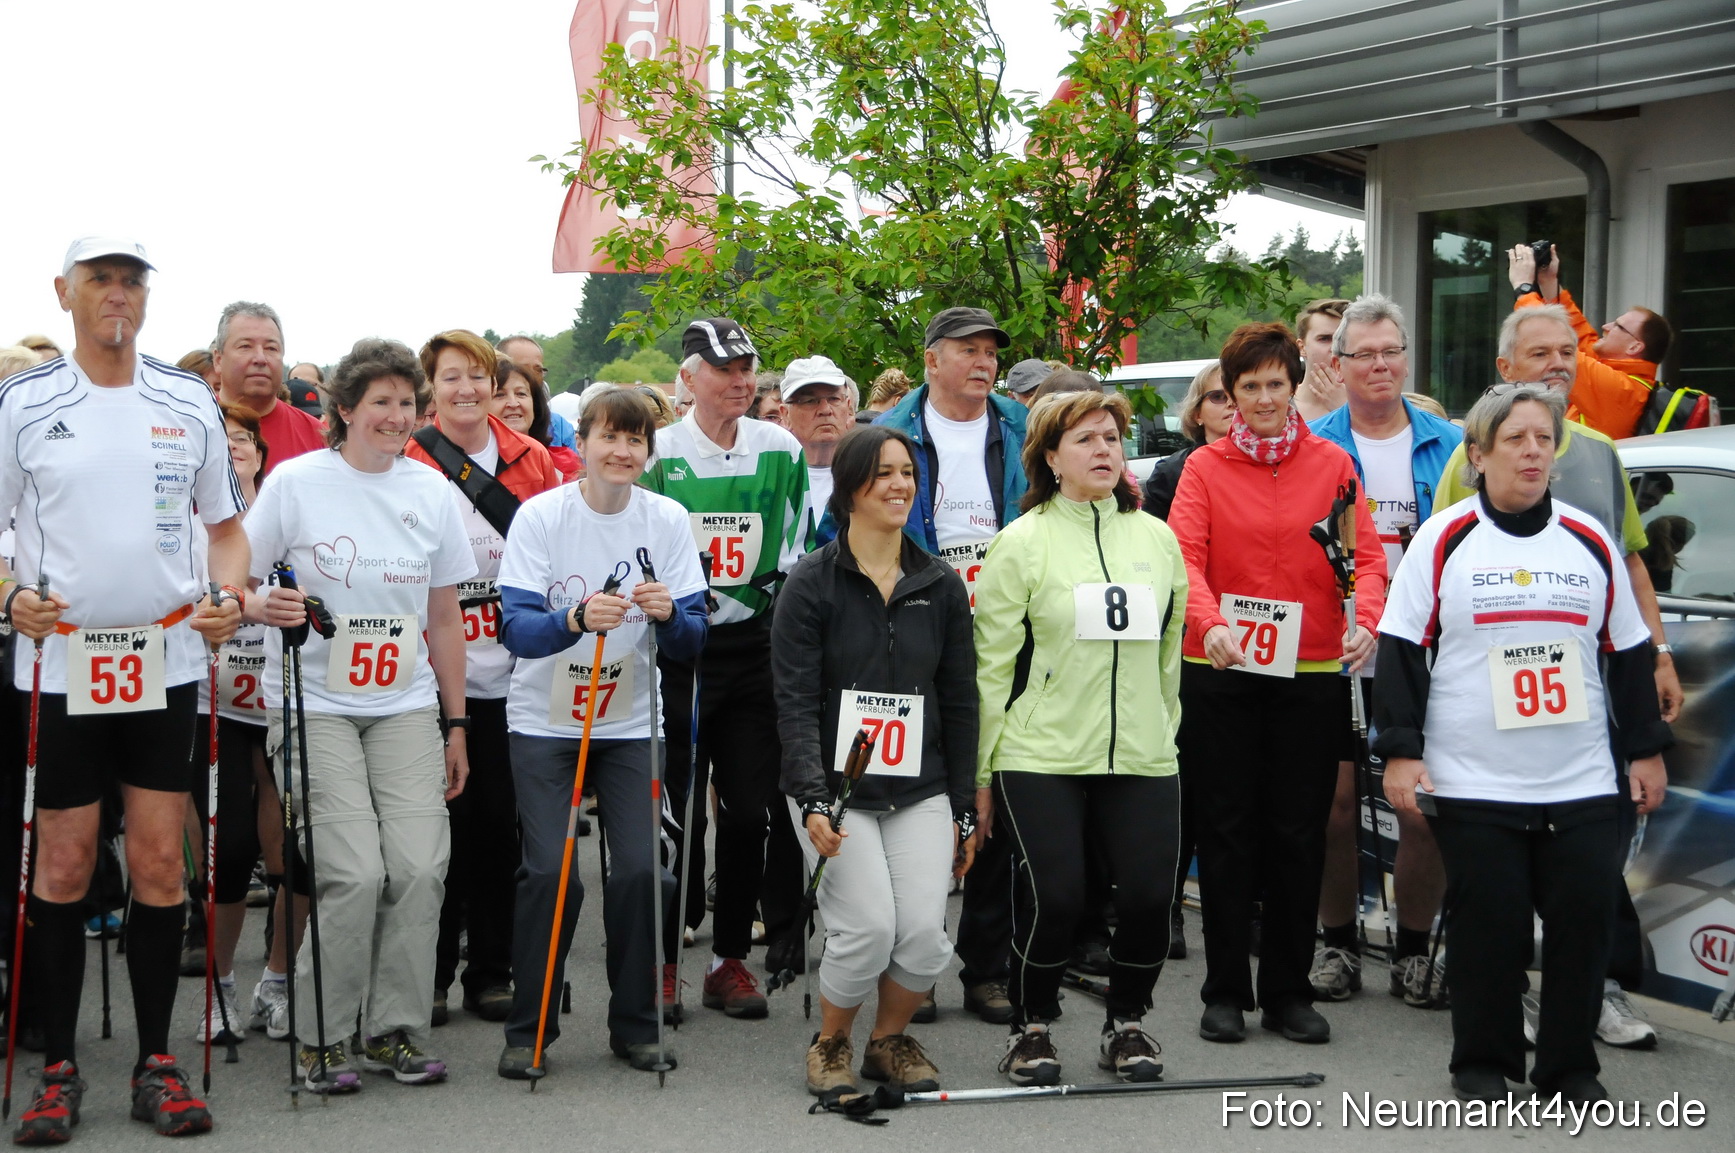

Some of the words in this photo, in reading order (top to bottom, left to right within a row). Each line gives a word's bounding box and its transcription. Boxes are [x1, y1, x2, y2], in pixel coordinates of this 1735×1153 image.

[44, 431, 76, 441] adidas
[151, 426, 186, 437] MERZ
[151, 441, 187, 452] SCHNELL
[943, 498, 975, 511] Sport
[702, 516, 737, 525] MEYER
[702, 524, 737, 532] WERBUNG
[318, 554, 345, 567] Herz
[357, 555, 388, 569] Sport
[707, 536, 745, 579] 45
[457, 589, 487, 597] ERBUNG
[1472, 594, 1516, 604] Regensburger
[1104, 585, 1129, 632] 8
[1233, 598, 1271, 612] MEYER
[1233, 607, 1271, 619] WERBUNG
[348, 618, 387, 628] MEYER
[461, 600, 498, 642] 59
[84, 632, 129, 643] MEYER
[348, 628, 388, 636] WERBUNG
[84, 643, 130, 652] WERBUNG
[1236, 618, 1278, 666] 79
[1504, 645, 1546, 659] MEYER
[227, 654, 267, 665] MEYER
[348, 641, 400, 687] 56
[1504, 655, 1548, 666] WERBUNG
[568, 663, 608, 675] MEYR
[90, 653, 144, 705] 53
[1512, 666, 1567, 718] 95
[571, 681, 618, 722] 57
[856, 694, 896, 707] MEYER
[855, 704, 896, 715] WERBUNG
[860, 717, 906, 767] 70
[961, 812, 970, 836] LEKI
